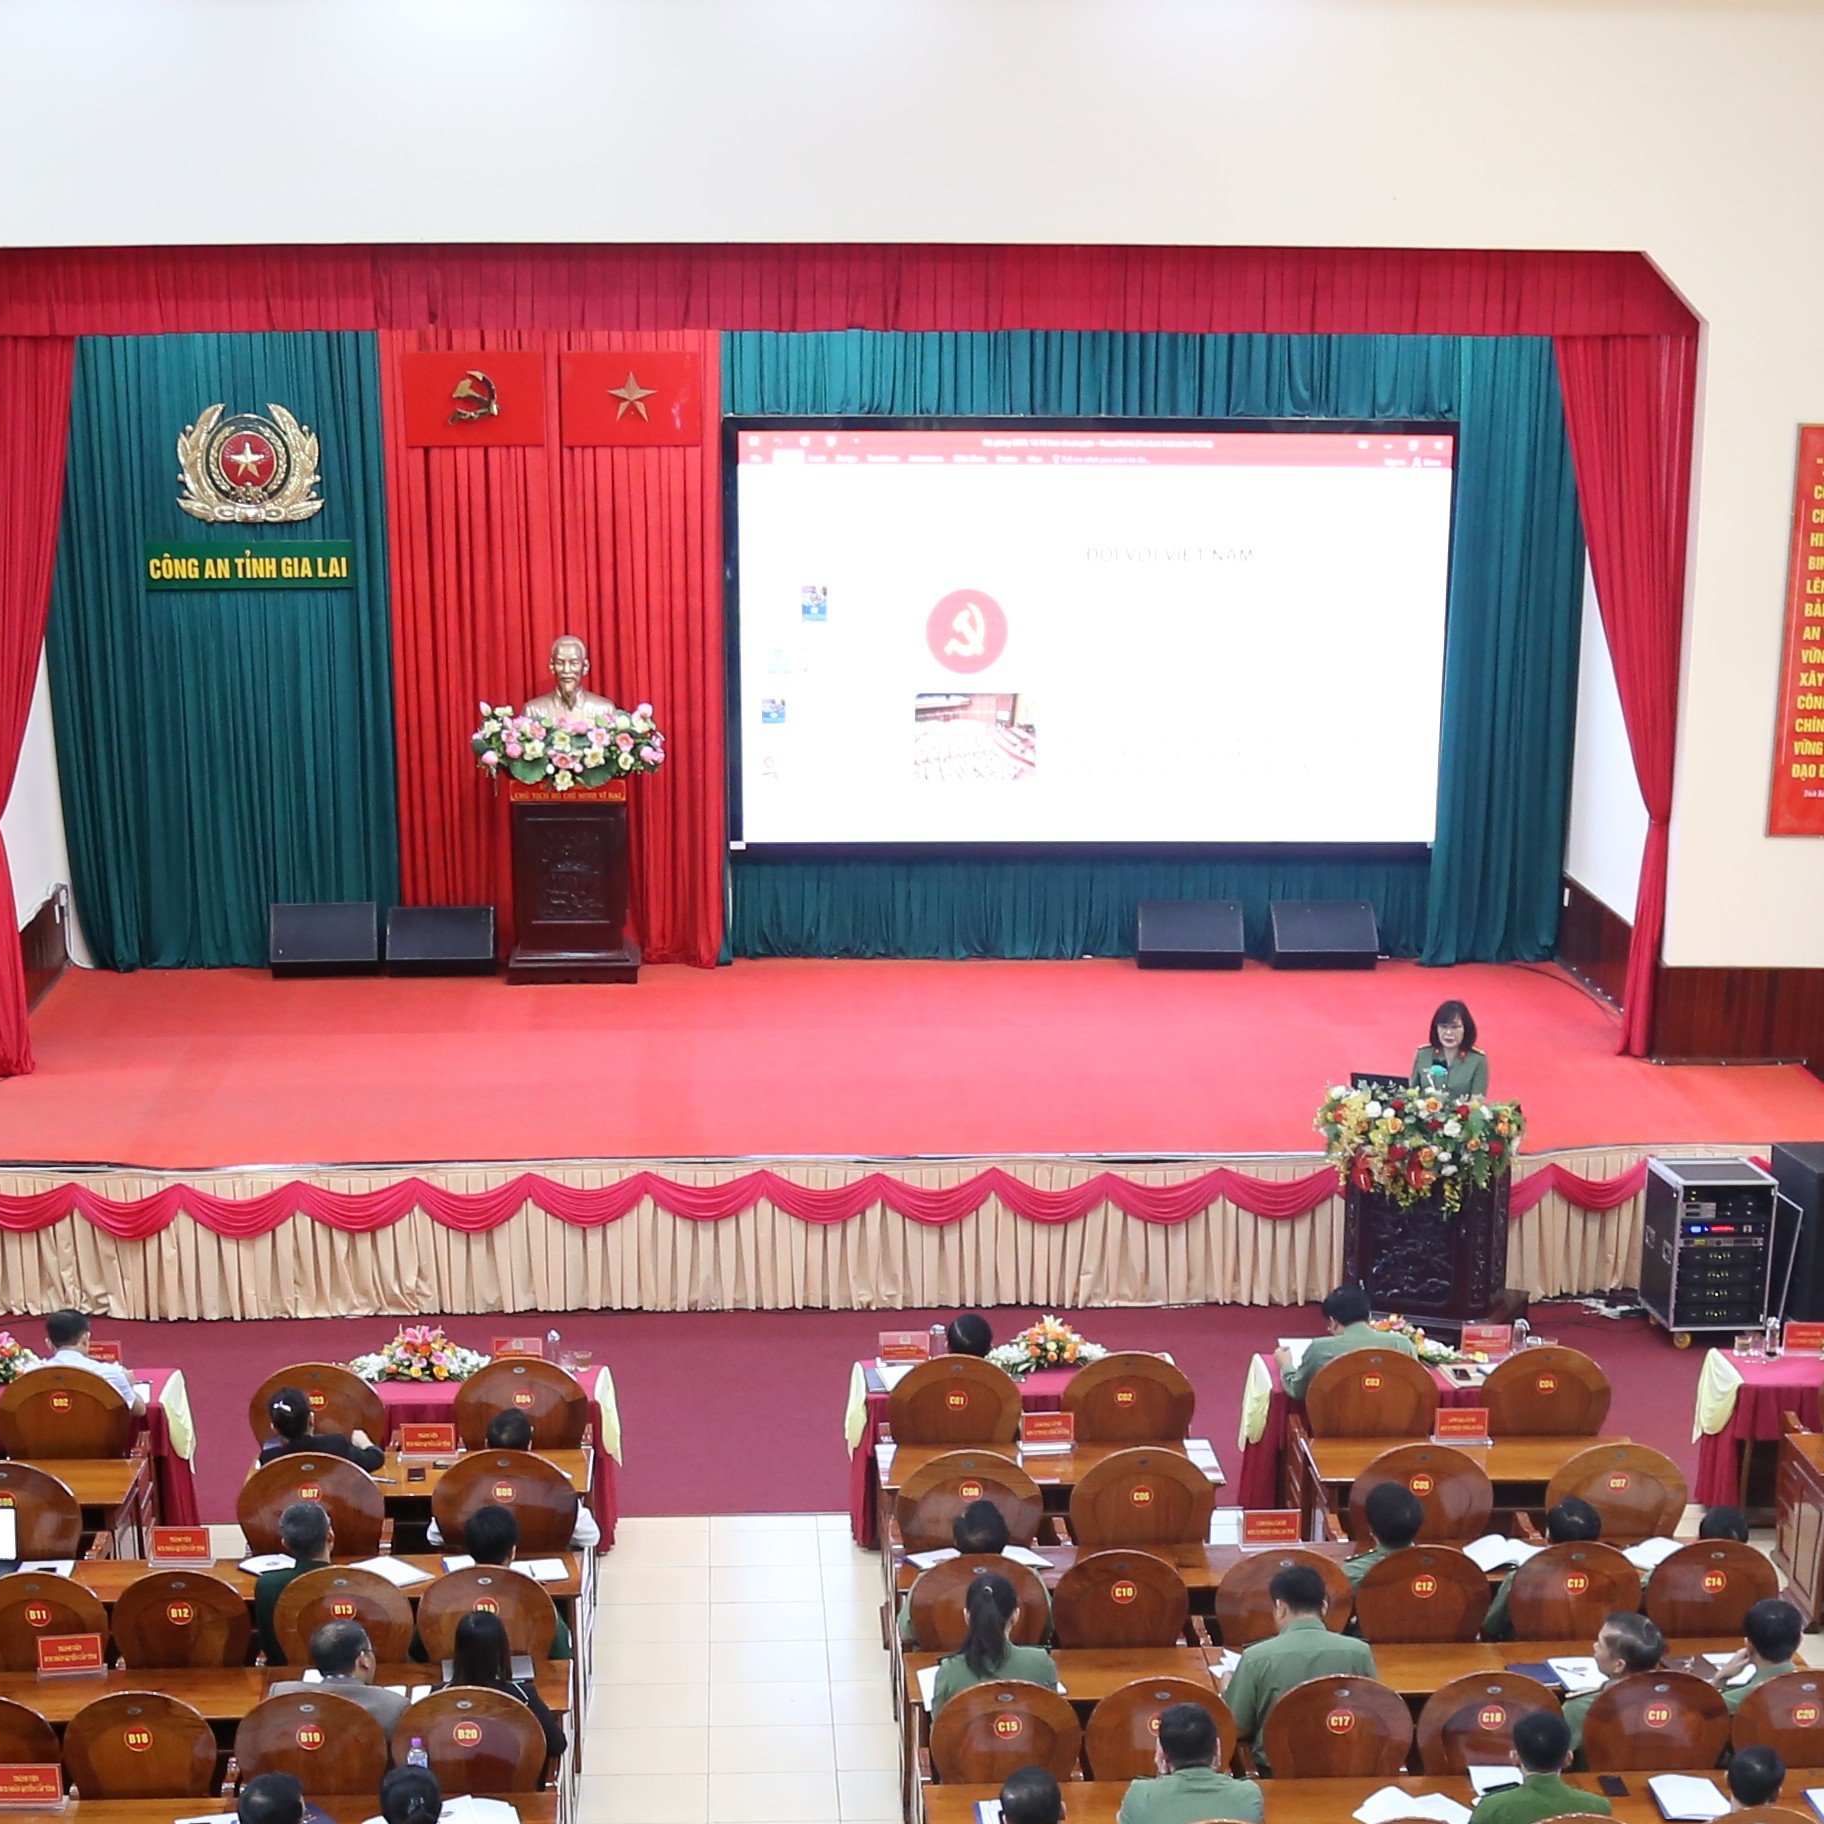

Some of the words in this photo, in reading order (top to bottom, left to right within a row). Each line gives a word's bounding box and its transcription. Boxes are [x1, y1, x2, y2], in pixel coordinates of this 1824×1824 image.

[149, 553, 199, 579] CÔNG
[204, 558, 230, 579] AN
[234, 549, 277, 579] TỈNH
[281, 557, 312, 578] GIA
[317, 557, 347, 578] LAI
[1414, 1581, 1434, 1592] C12
[1566, 1578, 1585, 1589] C13
[1704, 1576, 1723, 1587] C14
[1115, 1587, 1134, 1598] C10
[29, 1609, 47, 1620] B11
[170, 1607, 190, 1618] B12
[334, 1604, 353, 1615] B13
[1330, 1715, 1351, 1727] C17
[1647, 1710, 1668, 1721] C19
[997, 1720, 1018, 1732] C15
[128, 1733, 149, 1744] B18
